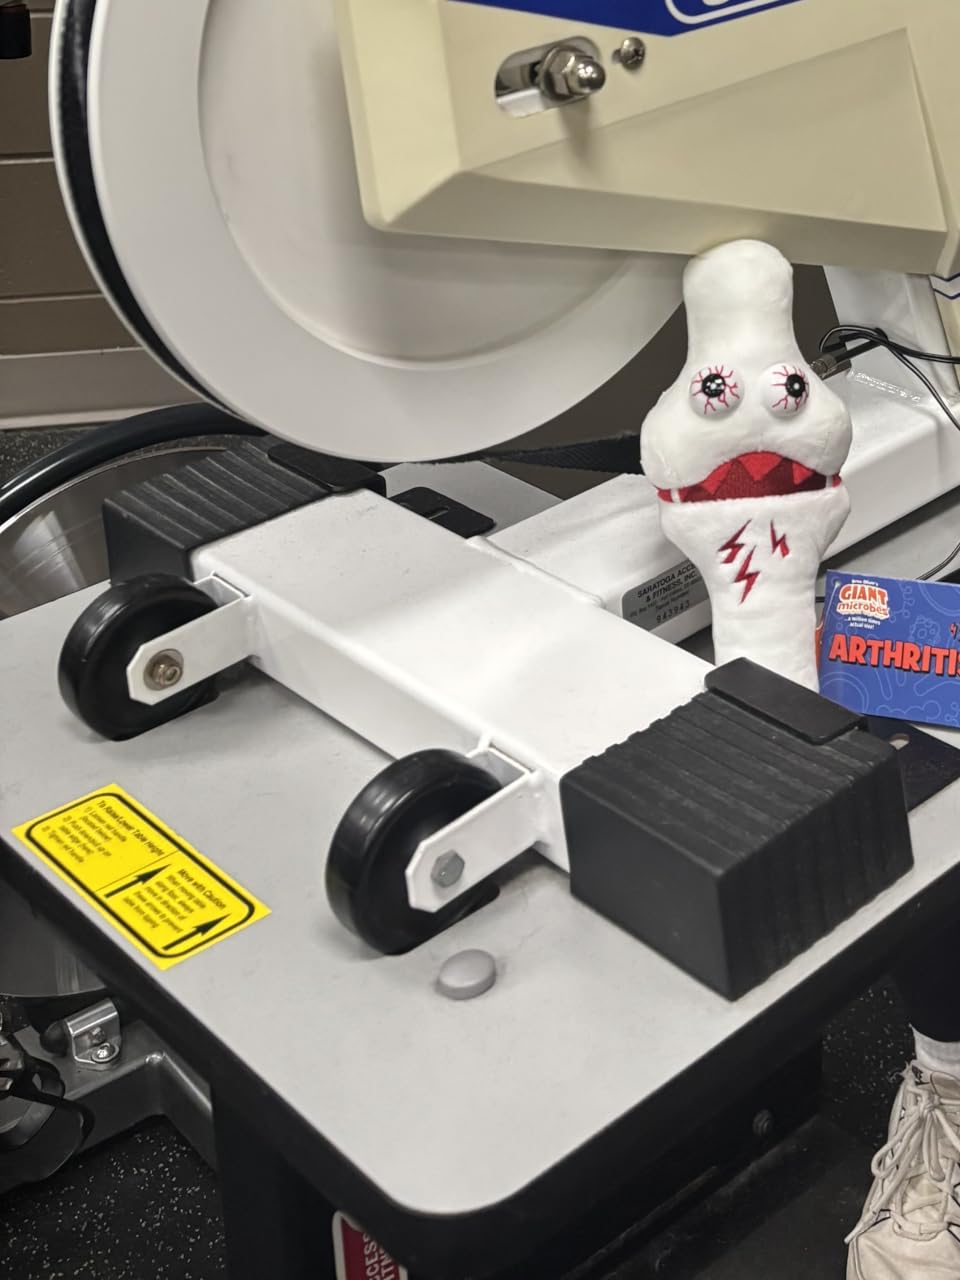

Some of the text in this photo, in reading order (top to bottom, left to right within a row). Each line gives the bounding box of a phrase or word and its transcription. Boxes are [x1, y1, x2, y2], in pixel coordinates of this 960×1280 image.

[841, 585, 887, 605] GIANT
[838, 602, 889, 616] microbes
[192, 881, 206, 892] with
[202, 890, 226, 909] Caution
